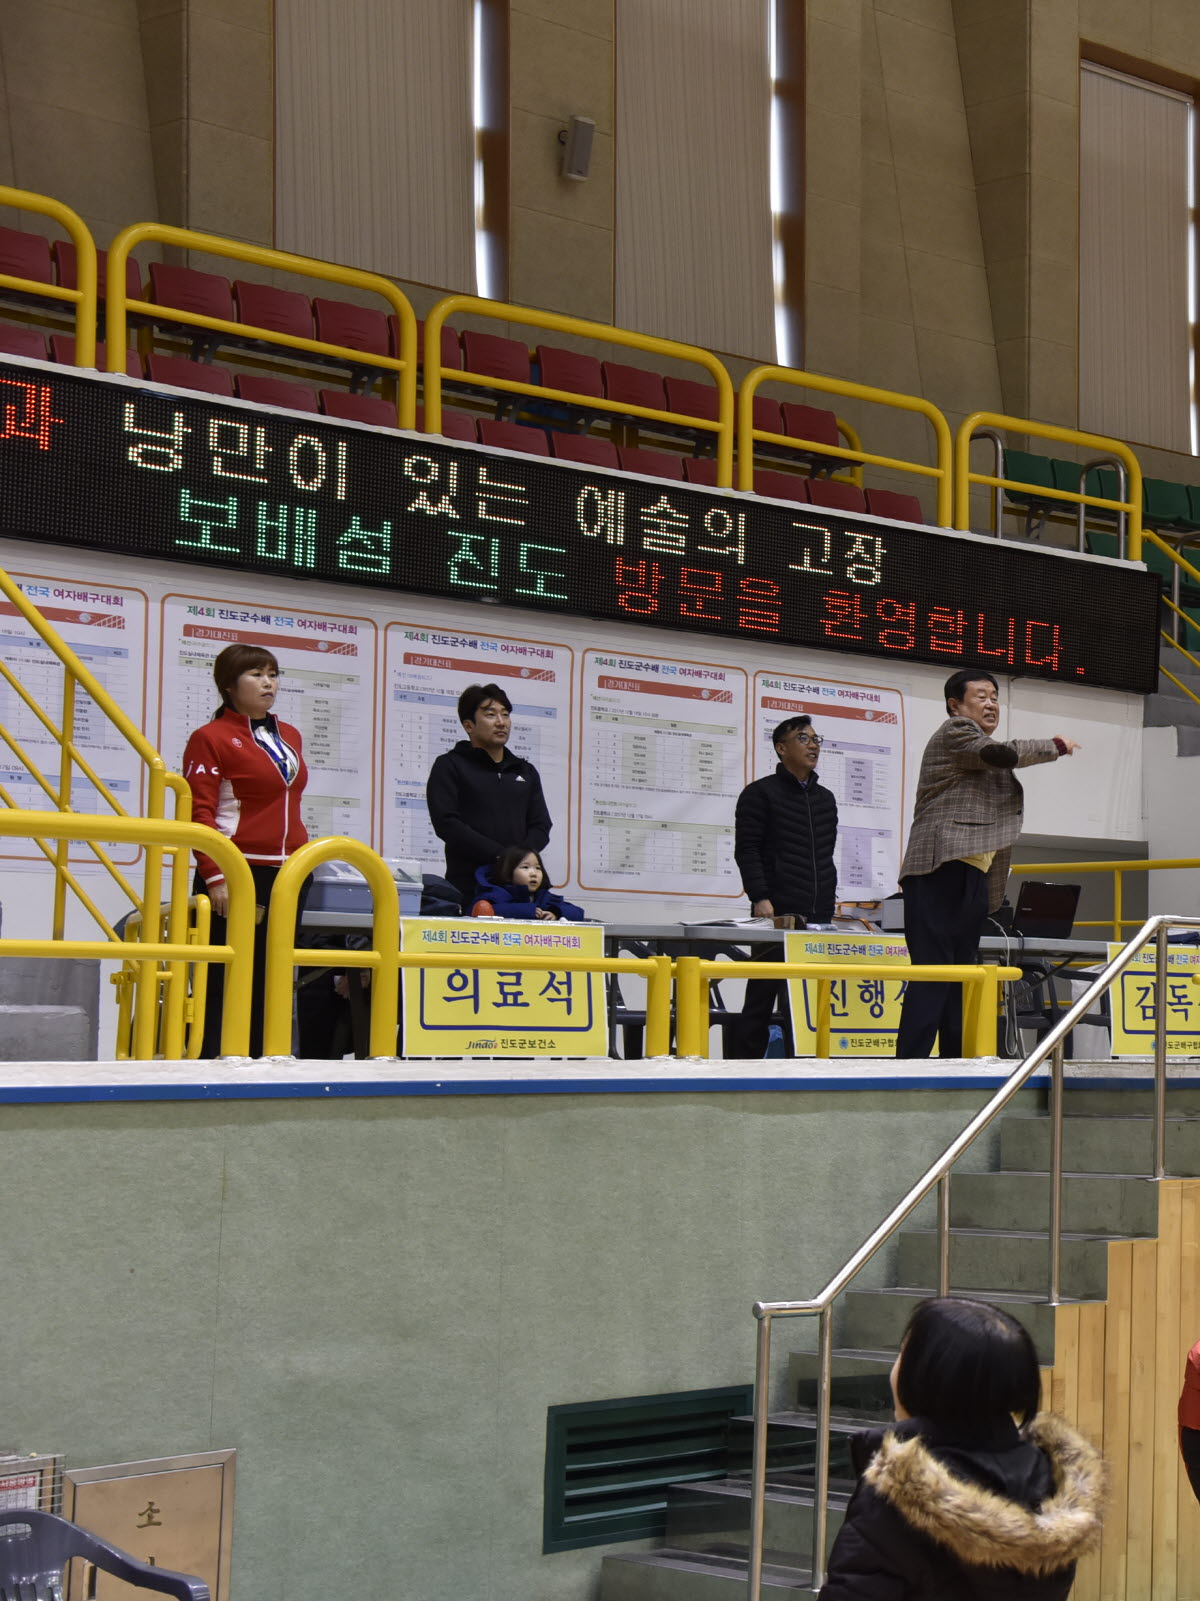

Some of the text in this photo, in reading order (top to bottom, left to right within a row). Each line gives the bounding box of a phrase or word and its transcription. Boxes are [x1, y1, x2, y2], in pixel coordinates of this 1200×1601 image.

[0, 379, 887, 586] 과 낭만이 있는 예술의 고장
[175, 488, 1086, 676] 보배섬 진도 방문을 환영합니다.
[26, 585, 50, 597] 전국
[53, 588, 124, 606] 여자배구대회
[187, 605, 357, 635] 제4회 진도군수배 전국 여자배구대회
[196, 628, 238, 640] 경기대진표
[404, 631, 554, 659] 제4회 진도군수배 전국 여자배구대회
[414, 656, 451, 668] 경기대진표
[594, 656, 725, 681] 제4회 진도군수배 전국 여자배구대회
[607, 678, 640, 691] 경기대진표
[761, 679, 881, 704] 제4회 진도군수배 전국 여자배구대회
[770, 702, 804, 712] 경기대진표
[421, 929, 581, 949] 제4회 진도군수배 전국 여자배구대회
[805, 943, 825, 954] 제4회
[827, 943, 866, 955] 진도군수배
[868, 945, 884, 956] 전국
[1176, 954, 1188, 965] 전국
[442, 968, 573, 1016] 의료석
[500, 1038, 556, 1050] 진도군보건소
